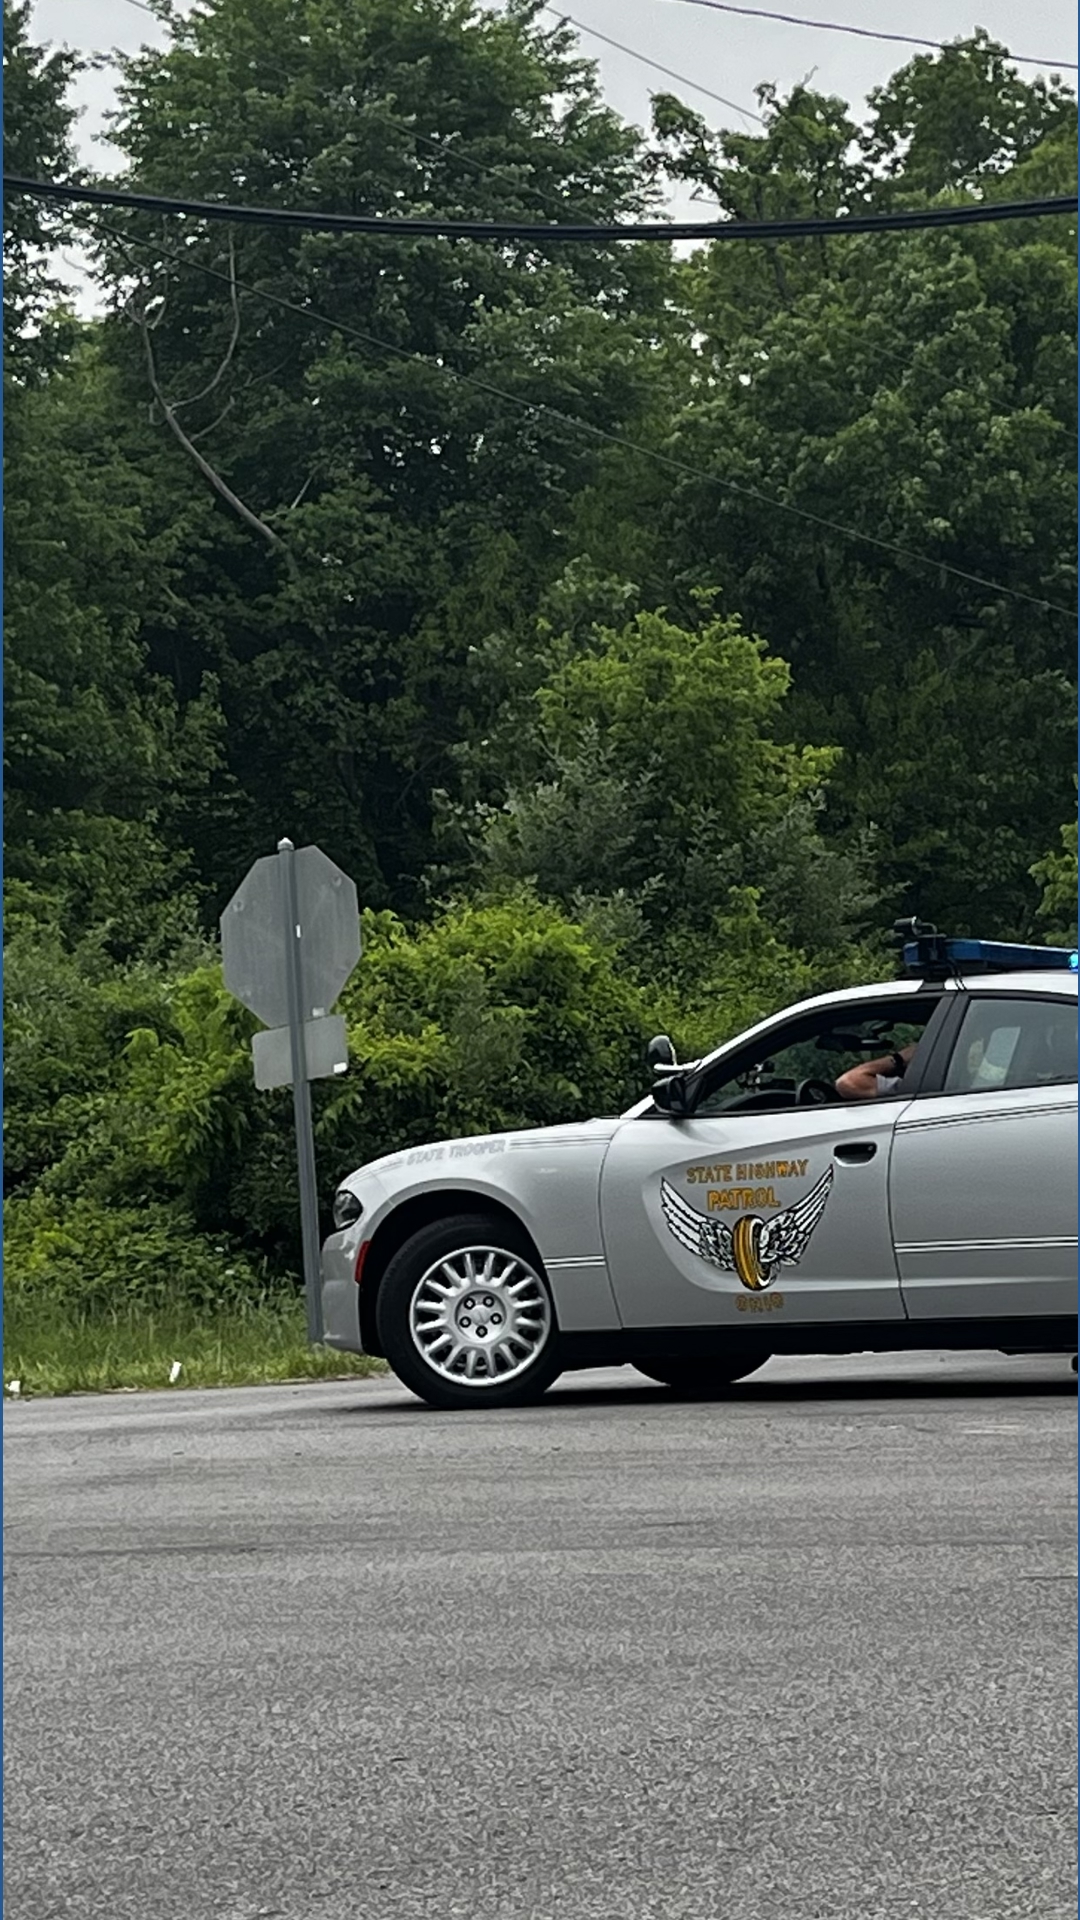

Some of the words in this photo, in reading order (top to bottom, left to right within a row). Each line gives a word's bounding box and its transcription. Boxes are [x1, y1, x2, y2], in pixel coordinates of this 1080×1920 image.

[406, 1147, 445, 1166] STATE
[449, 1139, 506, 1159] TROOPER
[686, 1164, 732, 1184] STATE
[735, 1159, 810, 1183] HIGHWAY
[707, 1186, 781, 1211] PATROL
[735, 1292, 784, 1313] OHIO
